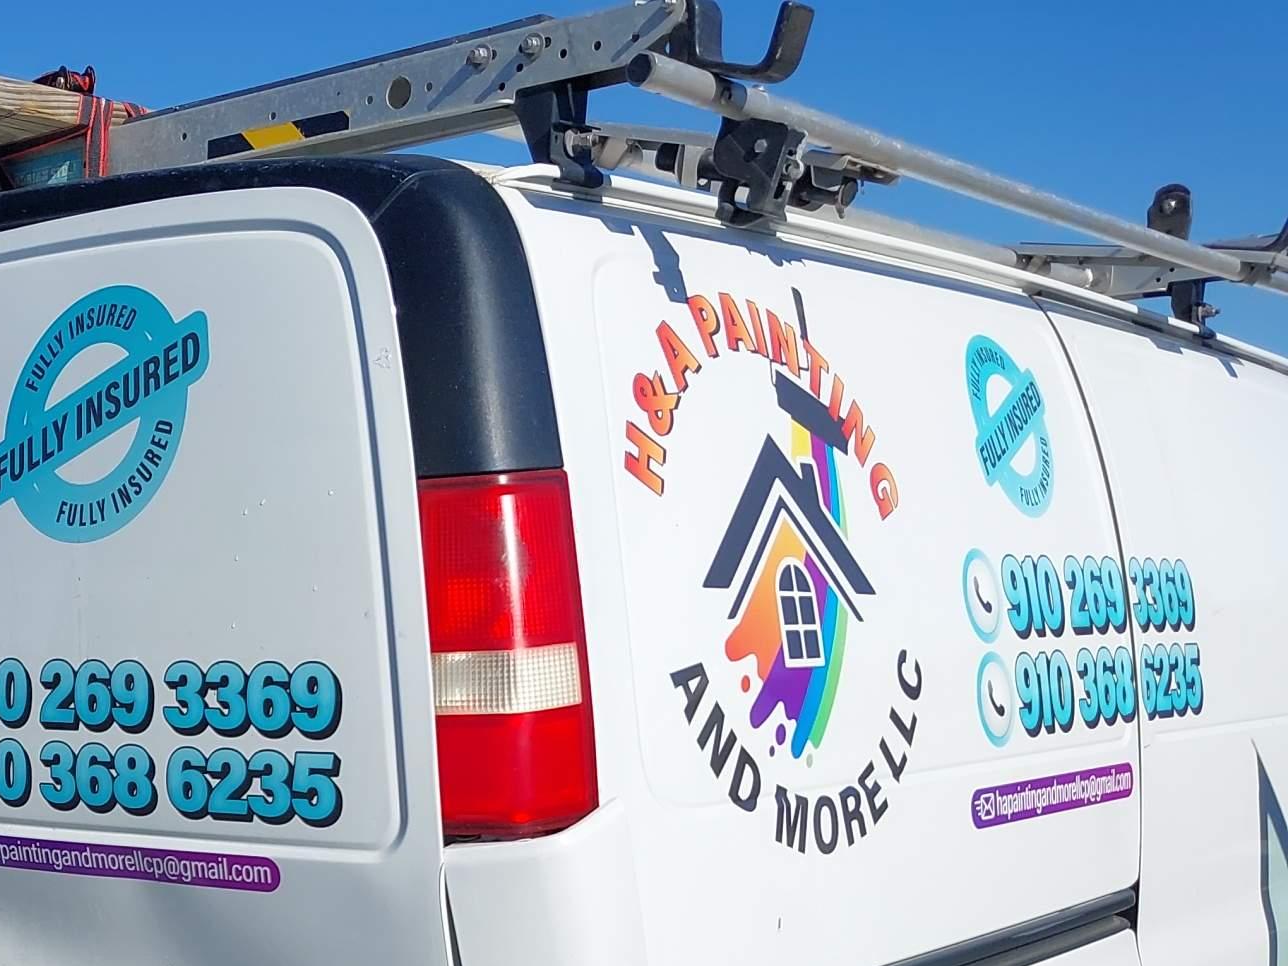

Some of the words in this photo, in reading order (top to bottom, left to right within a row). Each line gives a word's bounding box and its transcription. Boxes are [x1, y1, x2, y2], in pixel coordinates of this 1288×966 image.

[25, 331, 64, 392] FULLY
[68, 303, 137, 340] INSURED
[75, 331, 201, 440] INSURED
[974, 346, 1006, 371] INSURED
[624, 320, 701, 497] H&A
[688, 291, 899, 520] PAINTING
[979, 420, 1009, 476] FULLY
[1005, 381, 1042, 442] INSURED
[56, 499, 106, 527] FULLY
[111, 419, 174, 514] INSURED
[1019, 486, 1041, 507] FULLY
[1001, 554, 1065, 639] 910
[1064, 555, 1128, 634] 269
[1129, 556, 1196, 634] 3369
[39, 658, 154, 734] 269
[163, 659, 342, 739] 3369
[1015, 649, 1075, 738] 910
[1077, 646, 1136, 726] 368
[1140, 642, 1204, 721] 6235
[39, 739, 158, 815] 368
[166, 746, 342, 828] 6235
[669, 661, 761, 812] AND
[774, 760, 889, 856] MORE
[878, 648, 924, 785] LLC
